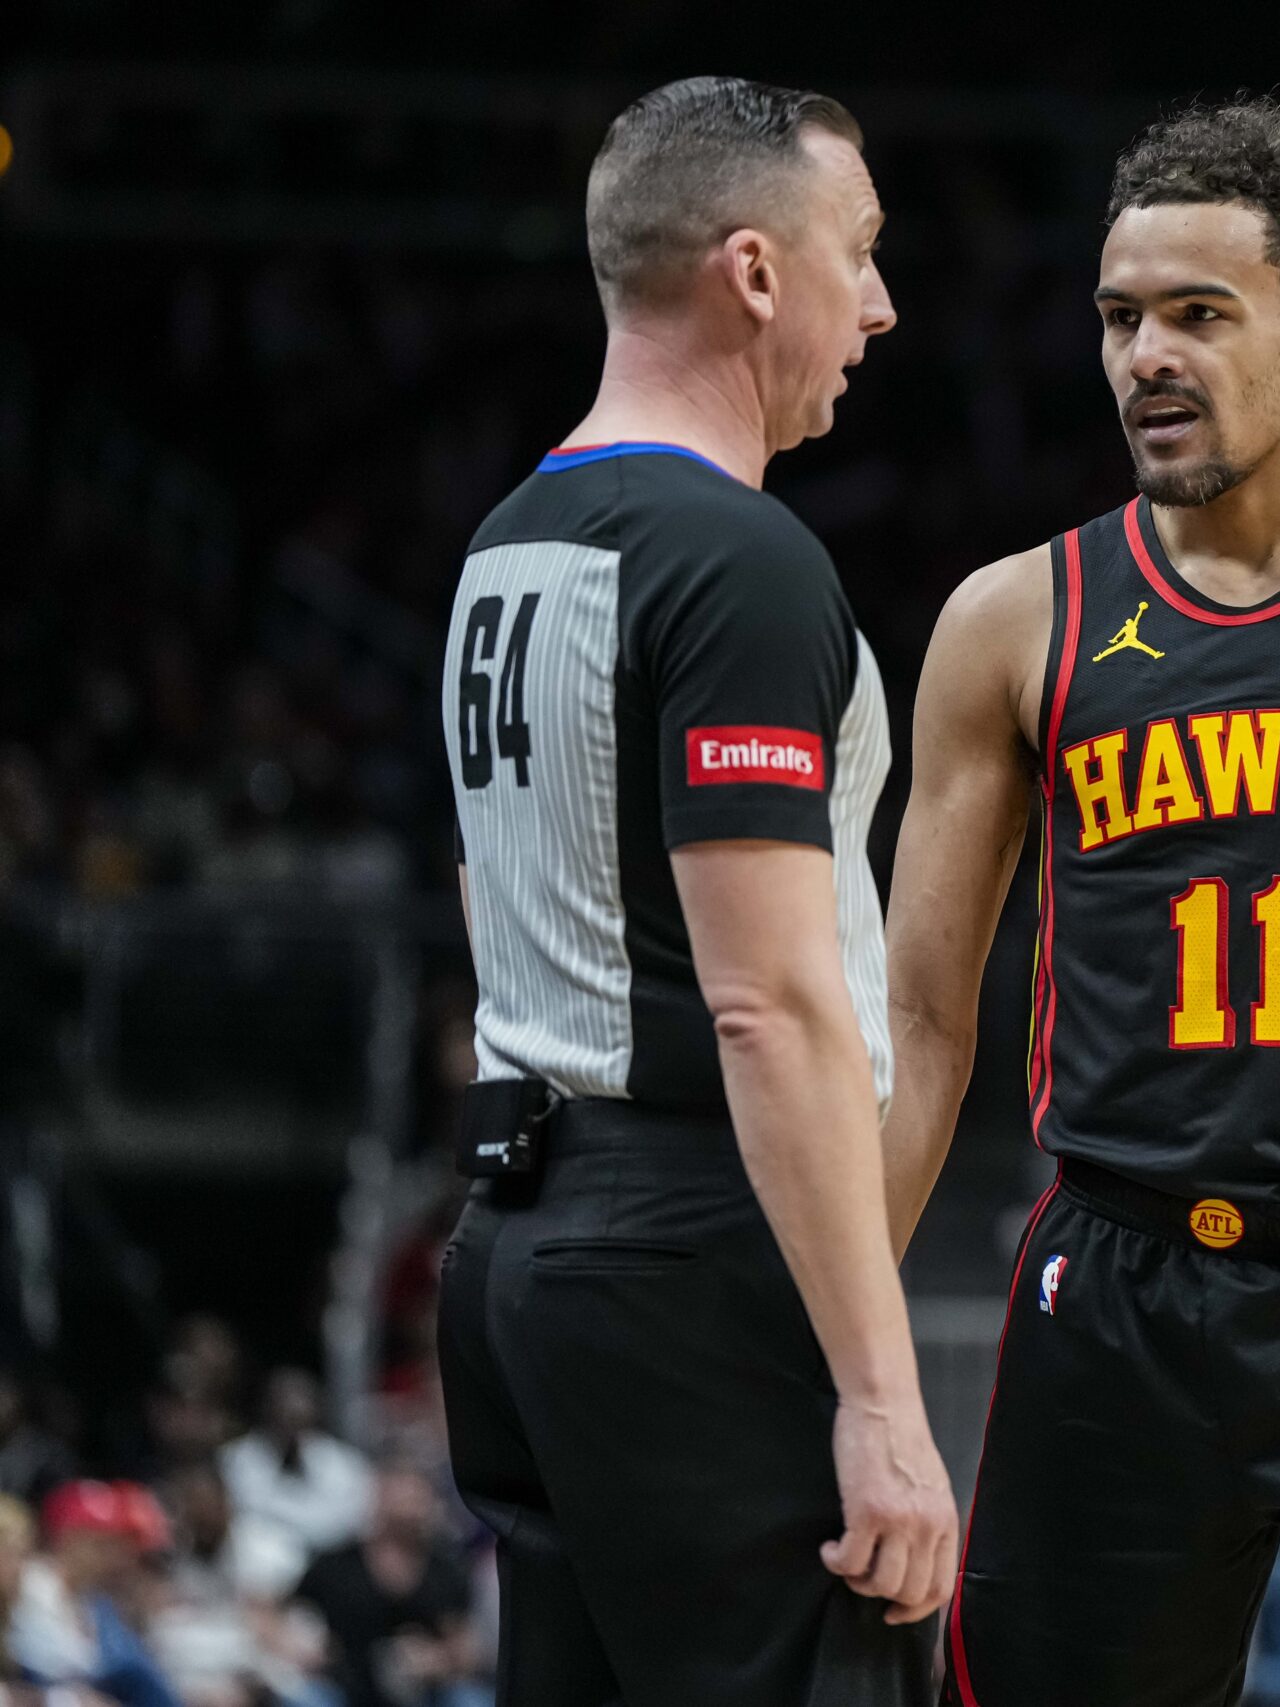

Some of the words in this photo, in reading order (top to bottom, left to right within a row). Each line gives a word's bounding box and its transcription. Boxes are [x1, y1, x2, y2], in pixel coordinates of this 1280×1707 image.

[458, 592, 542, 790] 64
[700, 738, 814, 775] Emirates
[1196, 1211, 1236, 1235] ATL
